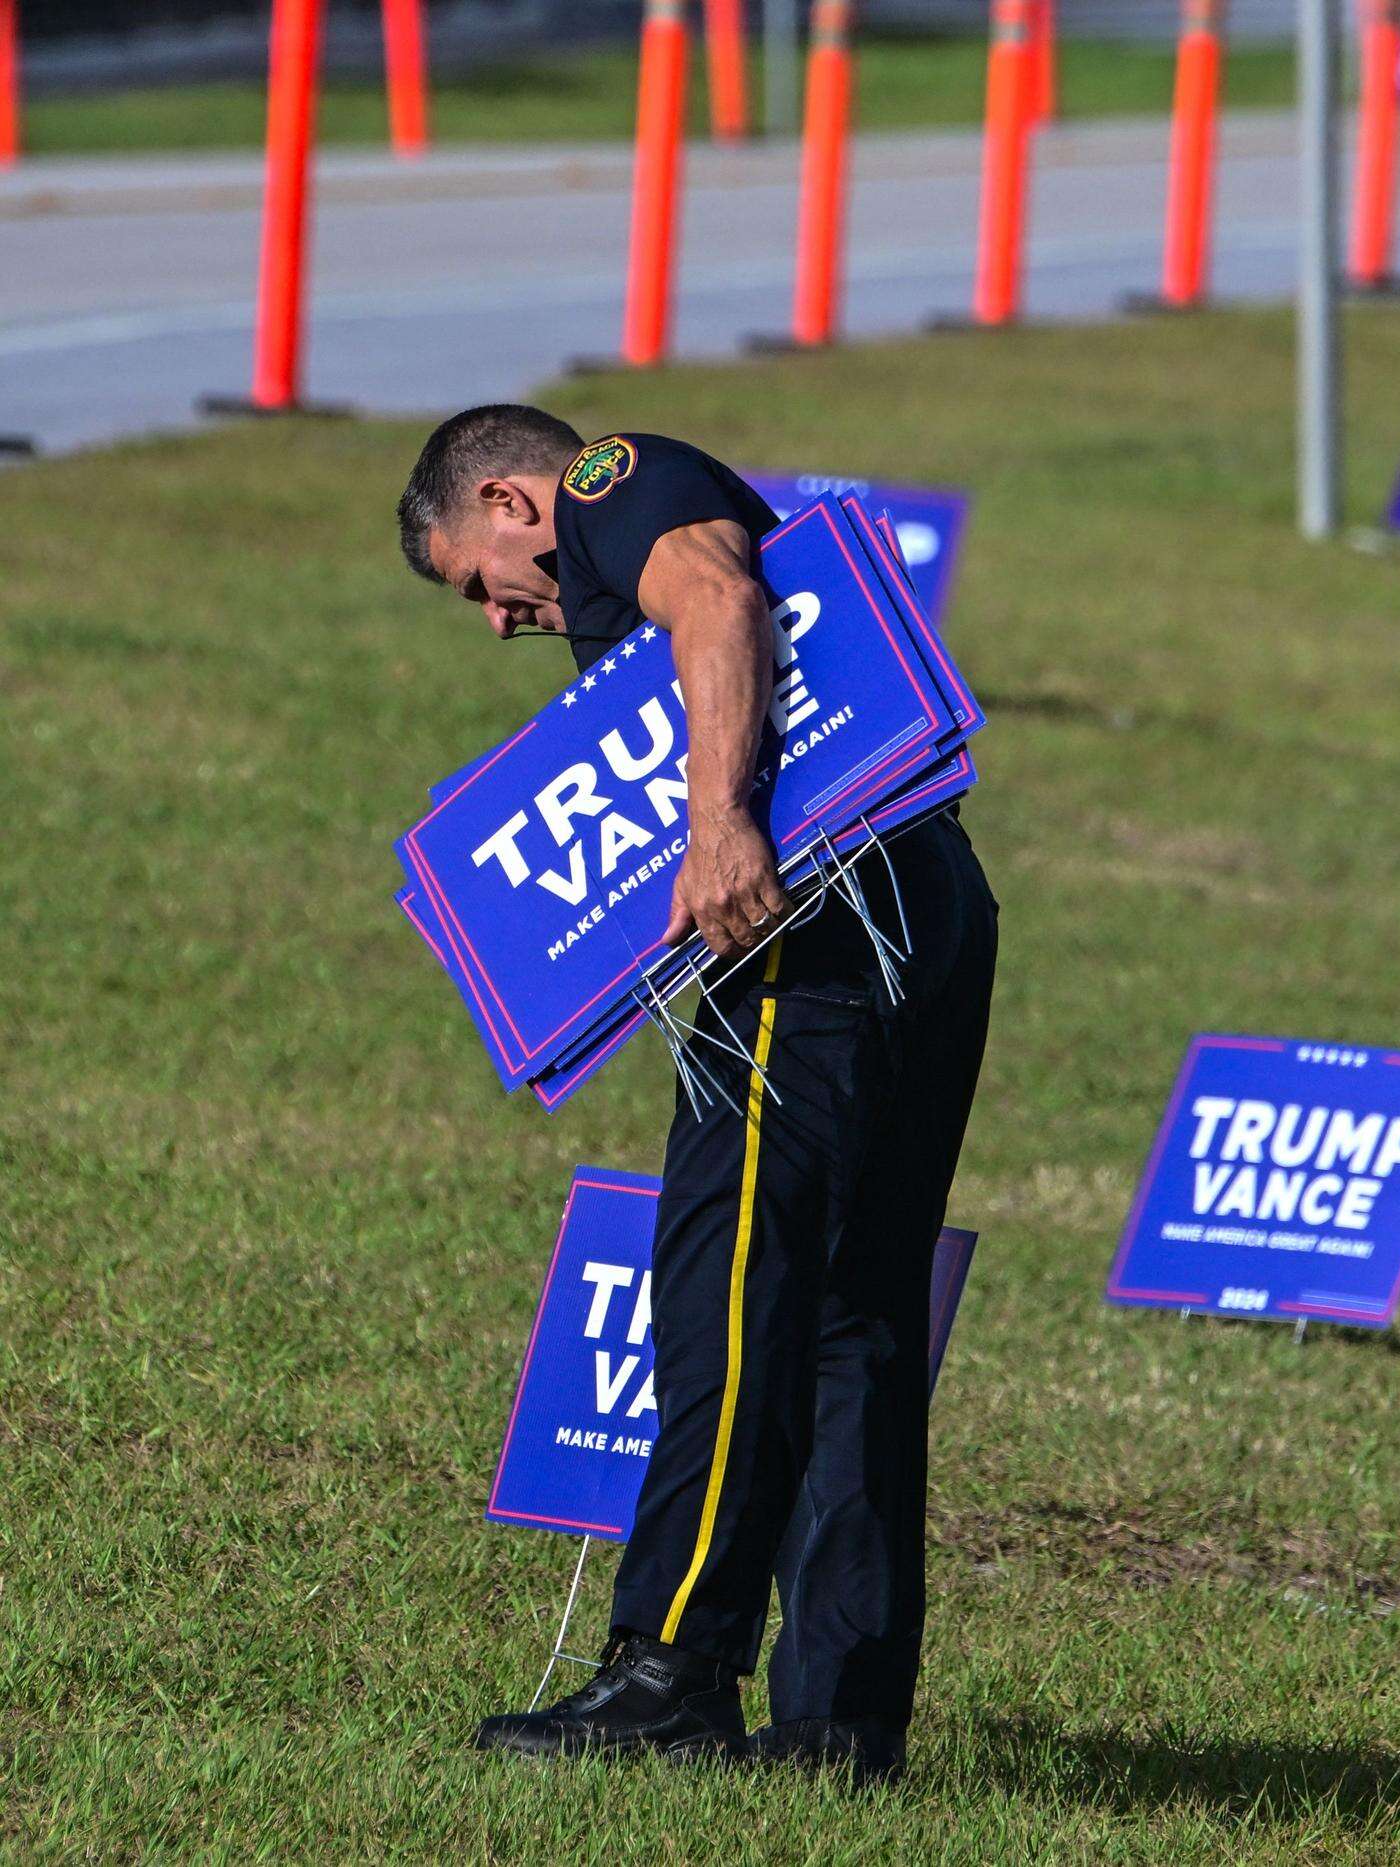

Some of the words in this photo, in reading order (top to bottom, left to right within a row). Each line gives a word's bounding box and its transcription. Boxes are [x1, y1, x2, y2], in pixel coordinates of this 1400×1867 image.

[471, 591, 821, 889] TRUP
[780, 705, 854, 770] AGAIN!
[536, 667, 820, 906] VANE
[547, 905, 605, 961] MAKE
[1193, 1162, 1383, 1230] VANCE
[555, 1427, 608, 1451] MAKE
